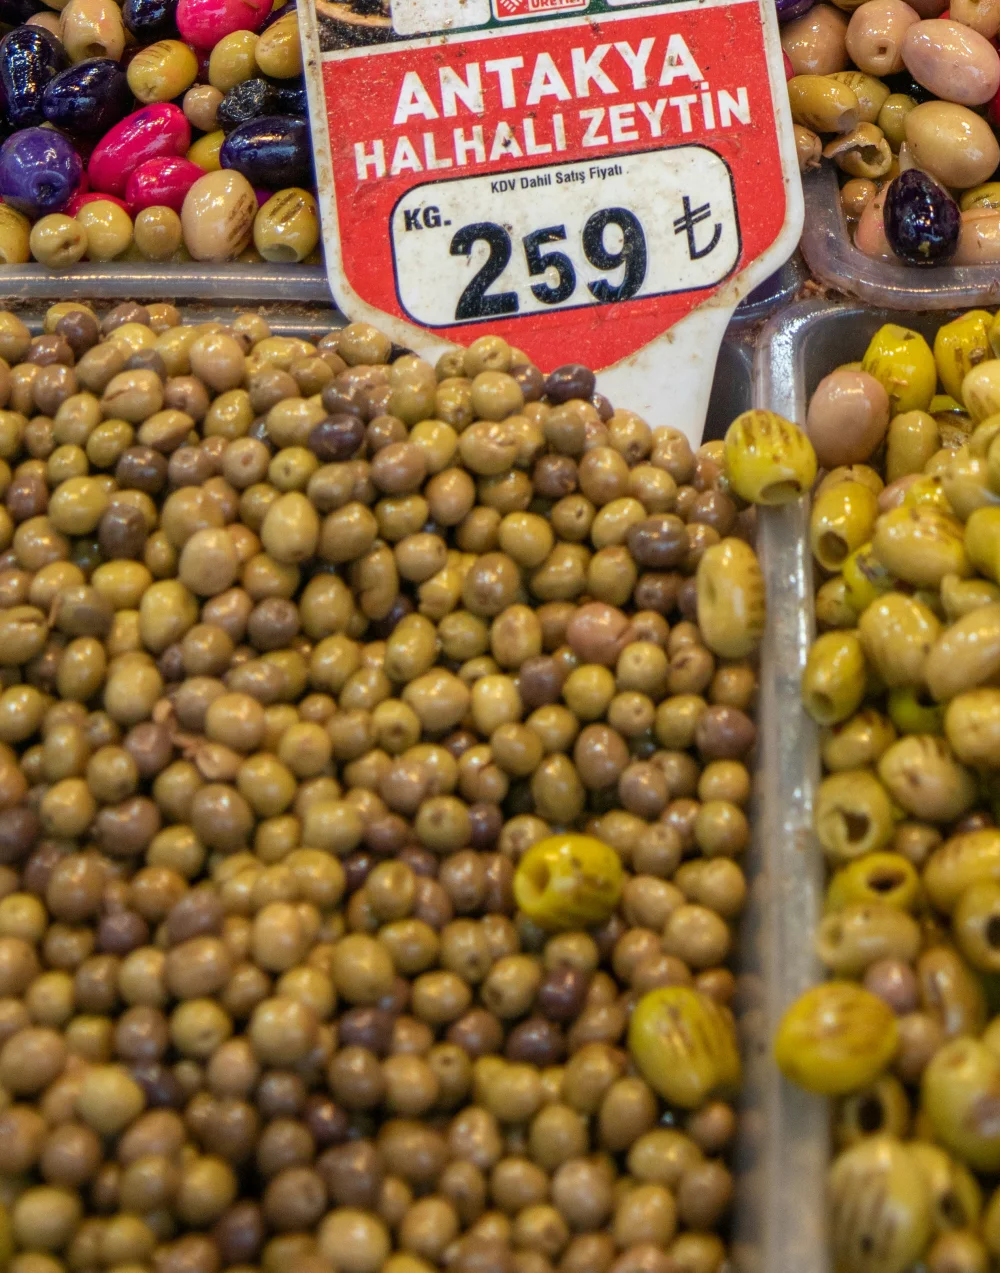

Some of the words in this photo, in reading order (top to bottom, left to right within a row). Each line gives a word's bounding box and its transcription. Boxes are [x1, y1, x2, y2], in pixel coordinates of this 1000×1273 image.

[393, 33, 705, 126] ANTAKYA
[354, 113, 569, 181] HALHALI
[579, 80, 752, 148] ZEYTİN
[404, 205, 452, 231] KG.
[491, 178, 516, 194] KDV
[520, 173, 552, 189] Dahil
[555, 170, 586, 184] Satış
[589, 164, 623, 180] Fiyatı
[449, 206, 648, 321] 259
